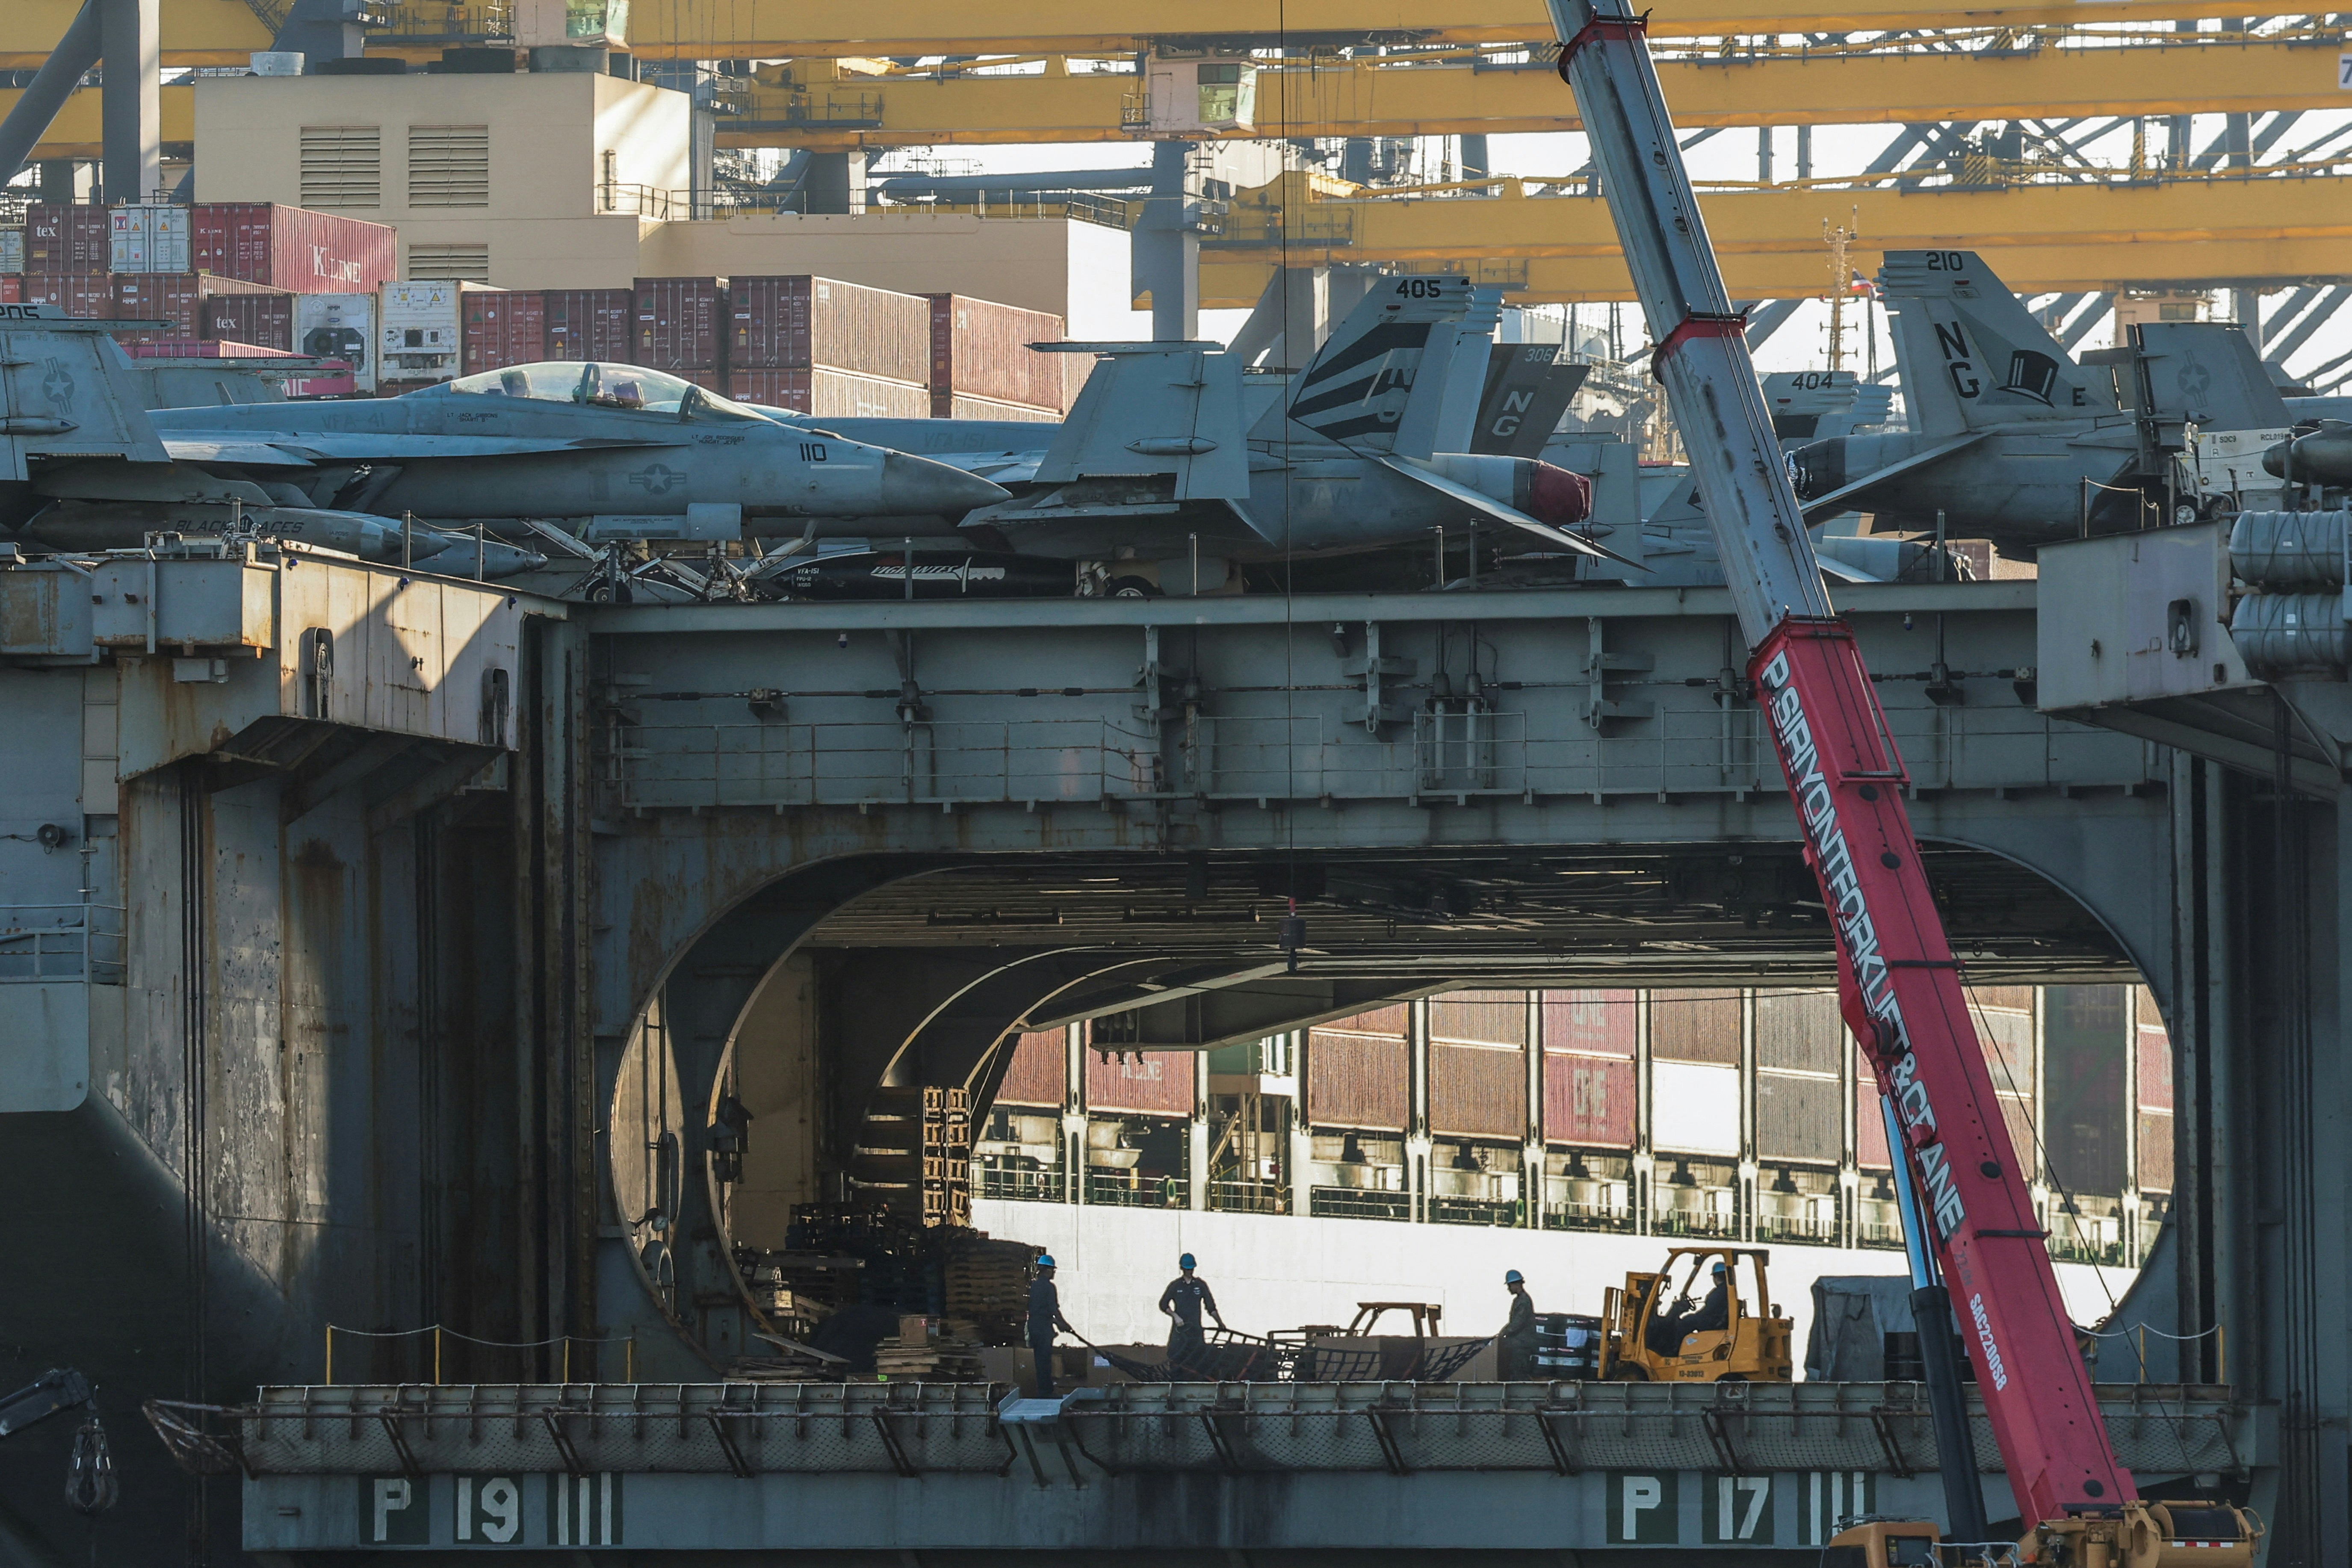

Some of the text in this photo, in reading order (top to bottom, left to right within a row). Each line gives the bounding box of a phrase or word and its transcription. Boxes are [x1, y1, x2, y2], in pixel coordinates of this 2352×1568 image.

[36, 224, 56, 237] tex
[313, 246, 360, 283] K LINE
[1926, 252, 1963, 271] 210
[1396, 280, 1441, 298] 405
[216, 316, 236, 328] tex
[1525, 348, 1554, 362] 306
[1792, 373, 1833, 391] 404
[2073, 387, 2086, 406] E
[800, 443, 826, 462] 110
[175, 520, 232, 532] BLACK
[257, 521, 304, 533] ACES
[374, 1479, 411, 1541] P
[458, 1477, 518, 1542] 19
[1623, 1476, 1661, 1540] P
[1719, 1477, 1768, 1539] 17
